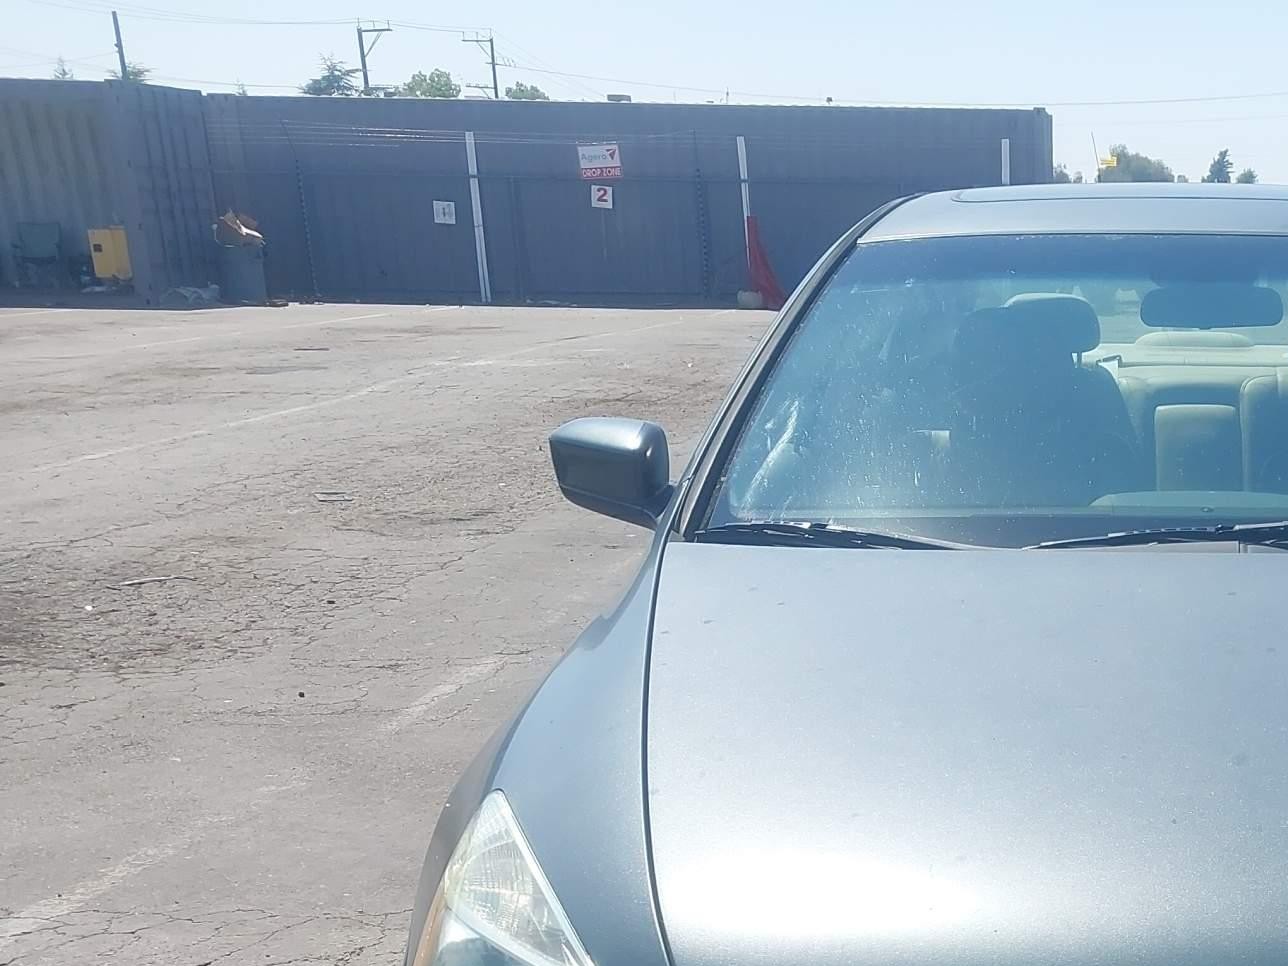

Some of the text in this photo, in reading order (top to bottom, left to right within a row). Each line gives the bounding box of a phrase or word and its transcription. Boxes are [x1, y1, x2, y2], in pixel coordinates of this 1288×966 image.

[582, 167, 622, 177] DROP ZONE
[596, 187, 609, 203] 2
